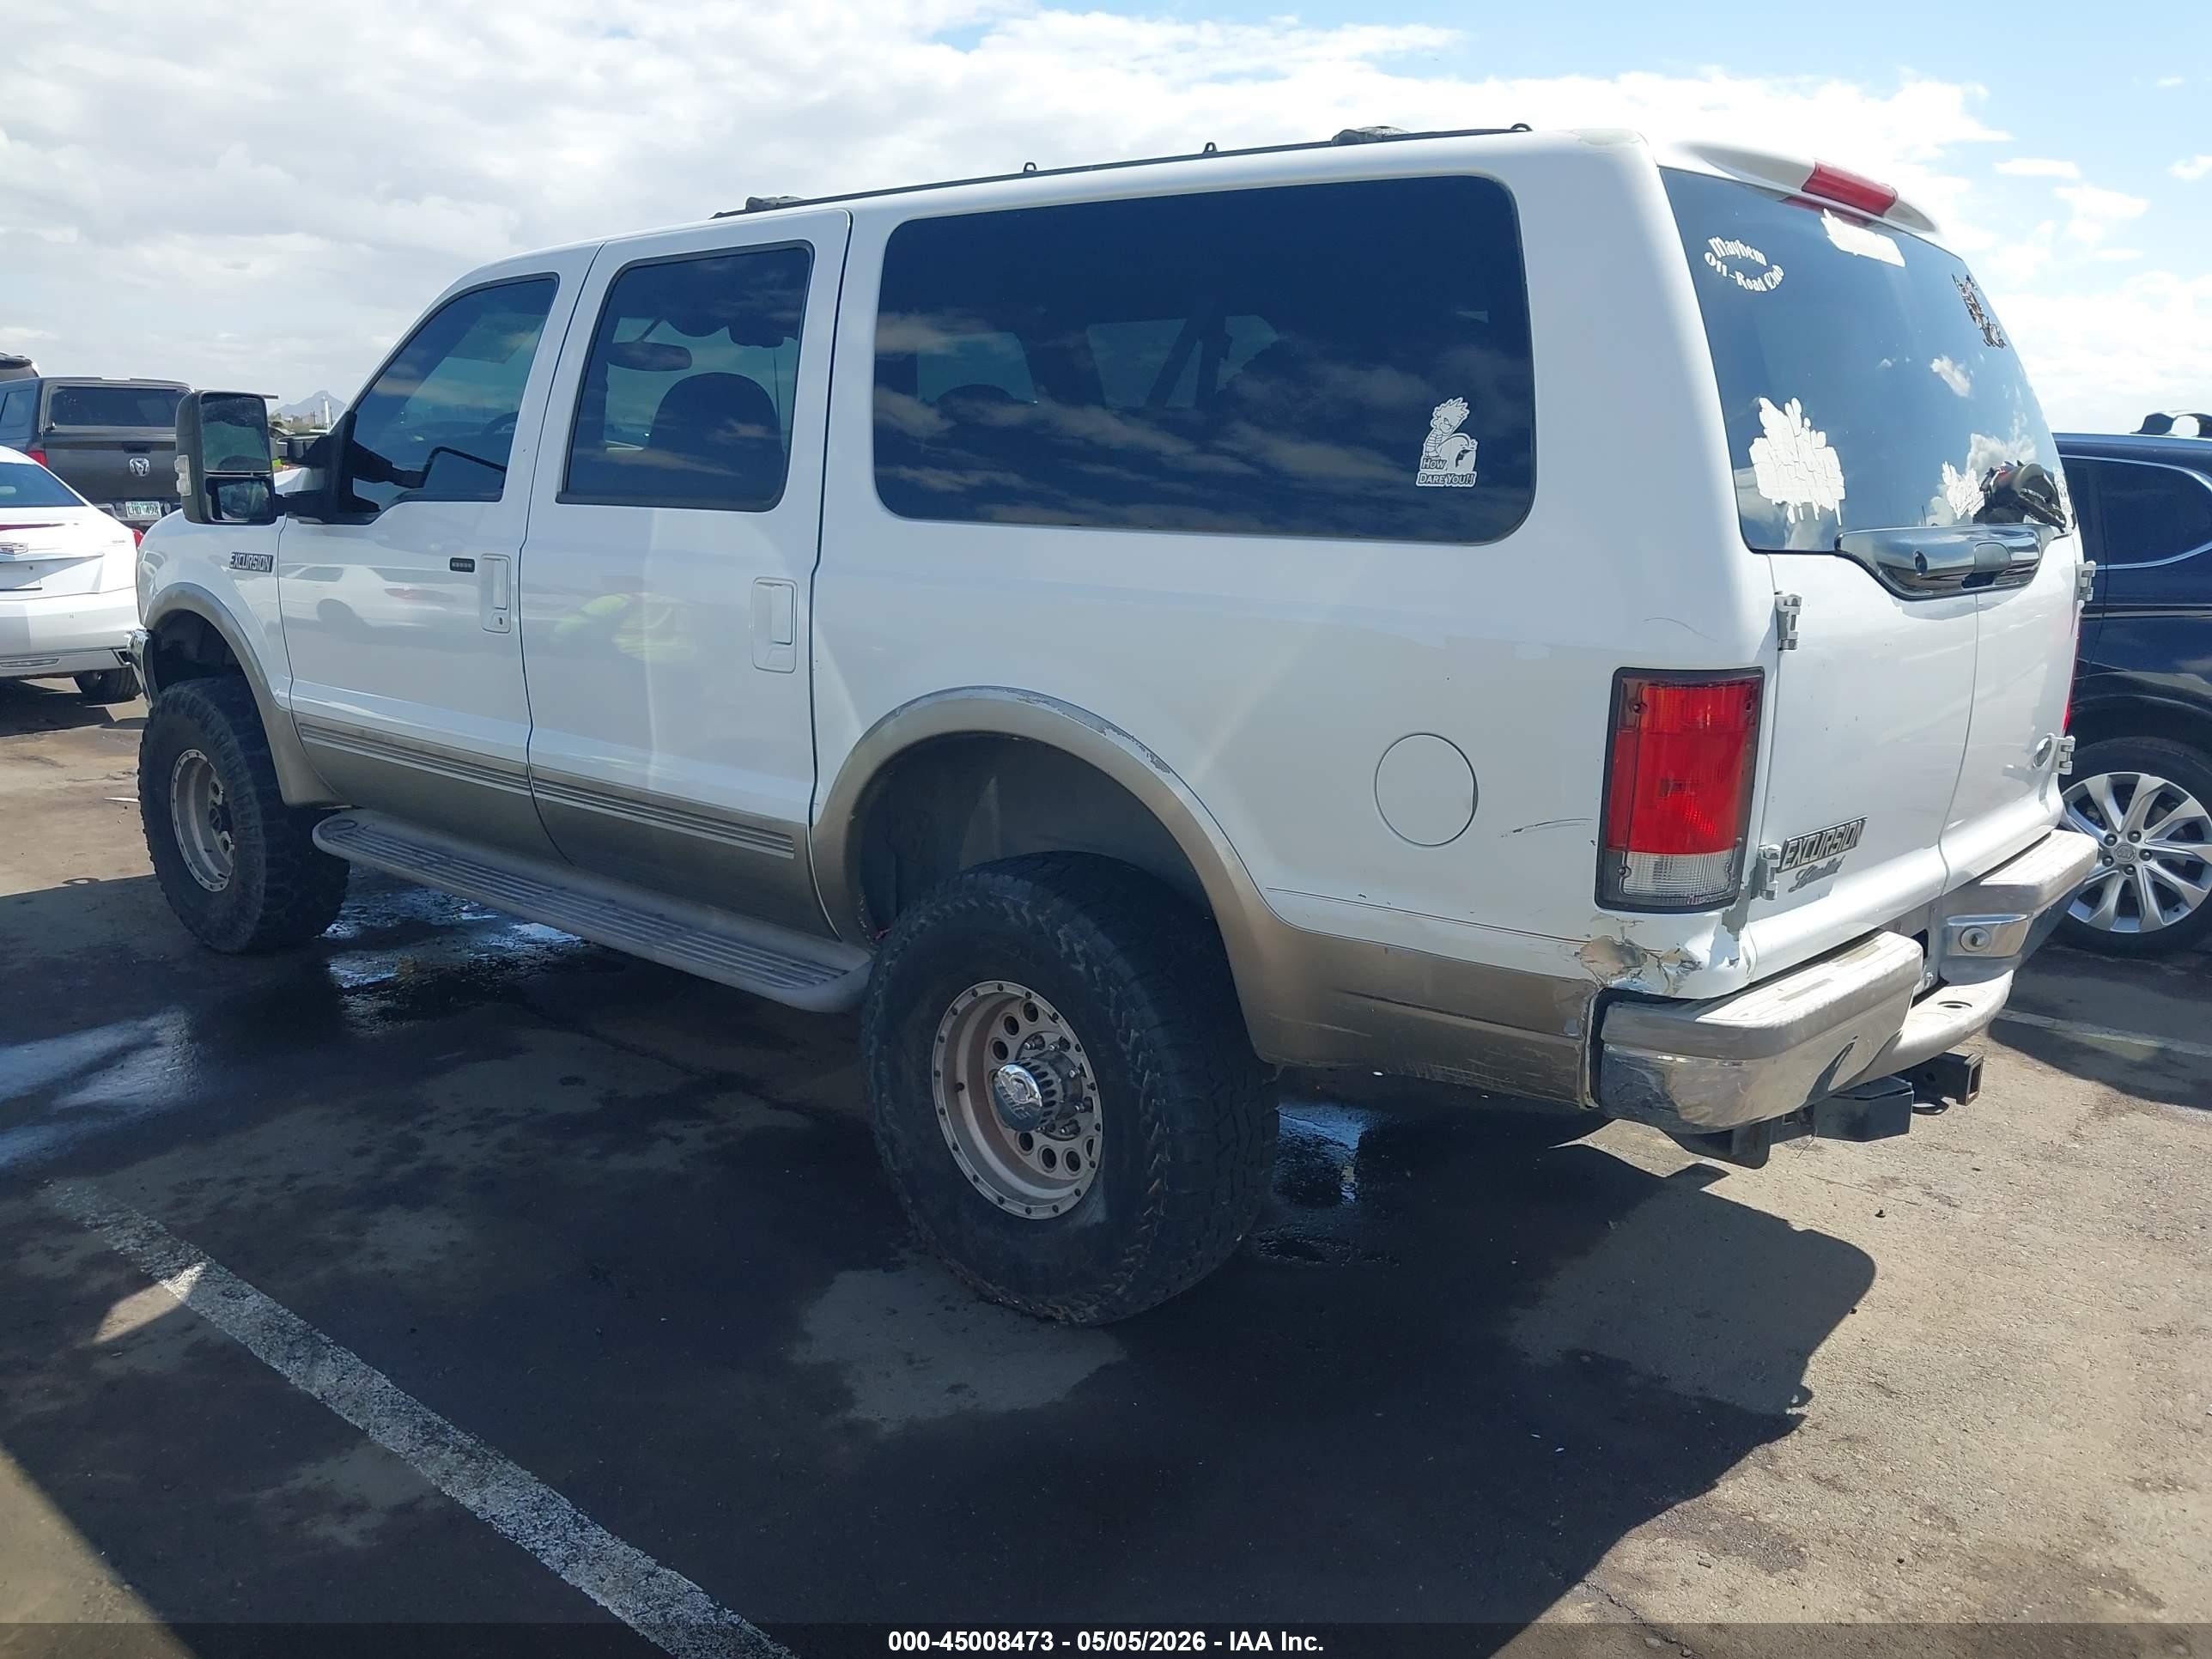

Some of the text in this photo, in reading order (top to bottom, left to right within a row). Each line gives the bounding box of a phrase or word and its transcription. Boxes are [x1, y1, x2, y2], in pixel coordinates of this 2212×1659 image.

[1708, 236, 1767, 266] Mayhem
[1763, 264, 1784, 290] Club
[230, 553, 271, 571] EXCURSION
[1781, 821, 1862, 870] EXCURSION
